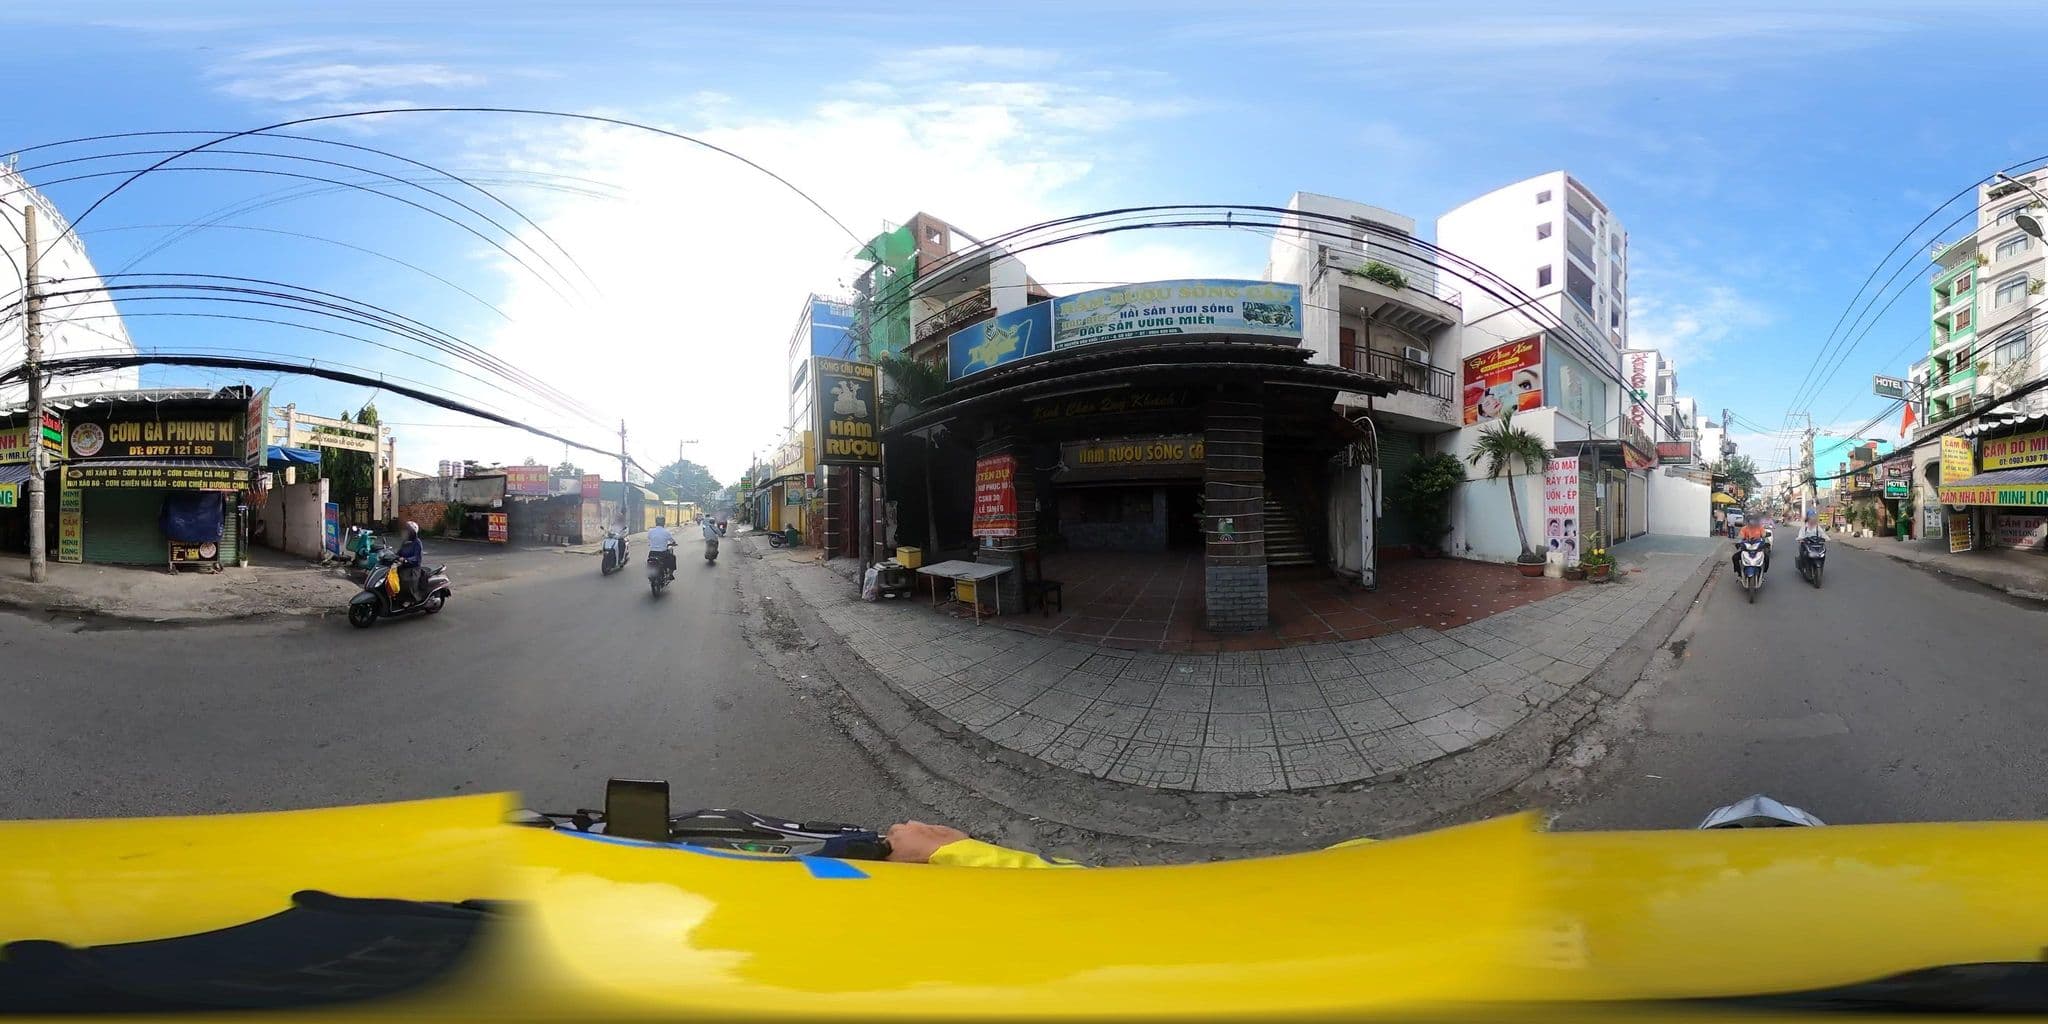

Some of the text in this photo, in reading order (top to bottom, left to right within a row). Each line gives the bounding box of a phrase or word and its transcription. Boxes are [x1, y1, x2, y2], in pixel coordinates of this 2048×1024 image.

[1144, 305, 1166, 316] SẢN
[1171, 304, 1197, 314] TƯƠI
[1108, 320, 1133, 332] SẢN
[1876, 377, 1902, 389] HOTEL
[110, 421, 140, 443] CƠM
[167, 421, 215, 446] PHỤNG
[830, 416, 872, 438] HẦM
[174, 445, 191, 455] 121
[194, 446, 213, 455] 530
[827, 438, 879, 460] RƯỢU
[1109, 445, 1142, 463] RƯỢU
[1147, 443, 1184, 460] SÔNG
[1888, 480, 1906, 488] HOTEL
[1999, 490, 2026, 504] MINH
